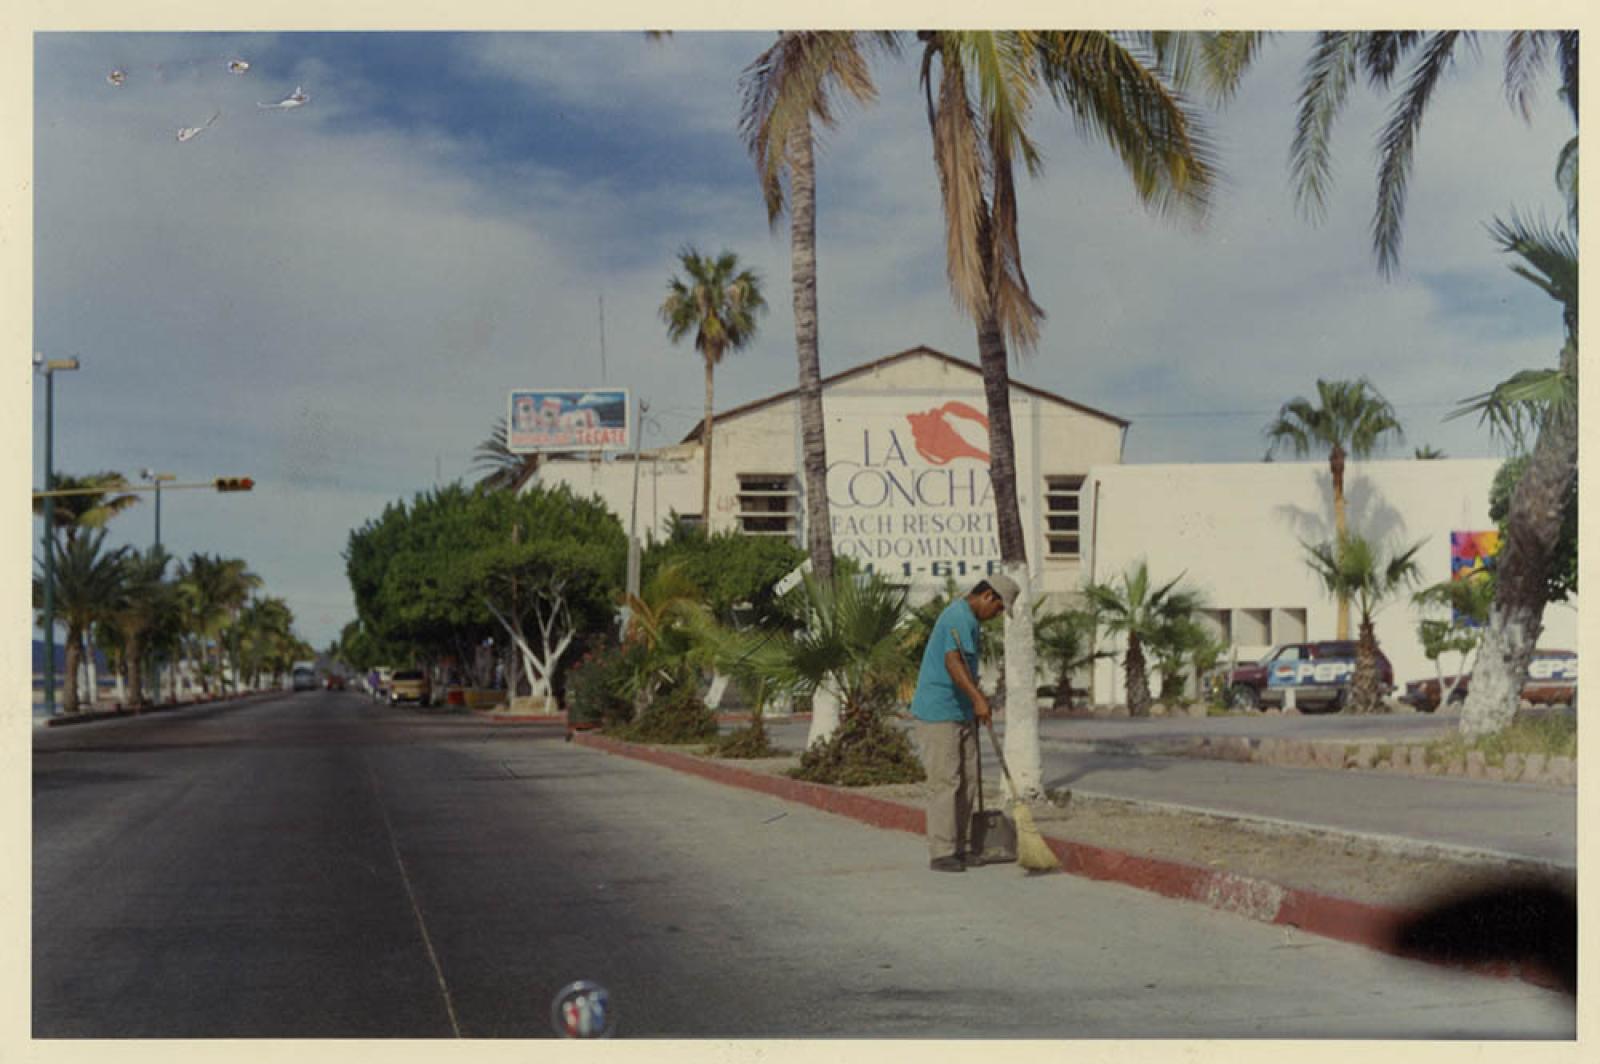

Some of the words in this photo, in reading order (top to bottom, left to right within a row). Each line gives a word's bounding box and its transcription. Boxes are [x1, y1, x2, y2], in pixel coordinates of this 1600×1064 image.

[863, 429, 908, 467] LA
[831, 514, 892, 535] EACH
[836, 536, 999, 559] ONDOMINIUM
[1528, 659, 1577, 679] EPS
